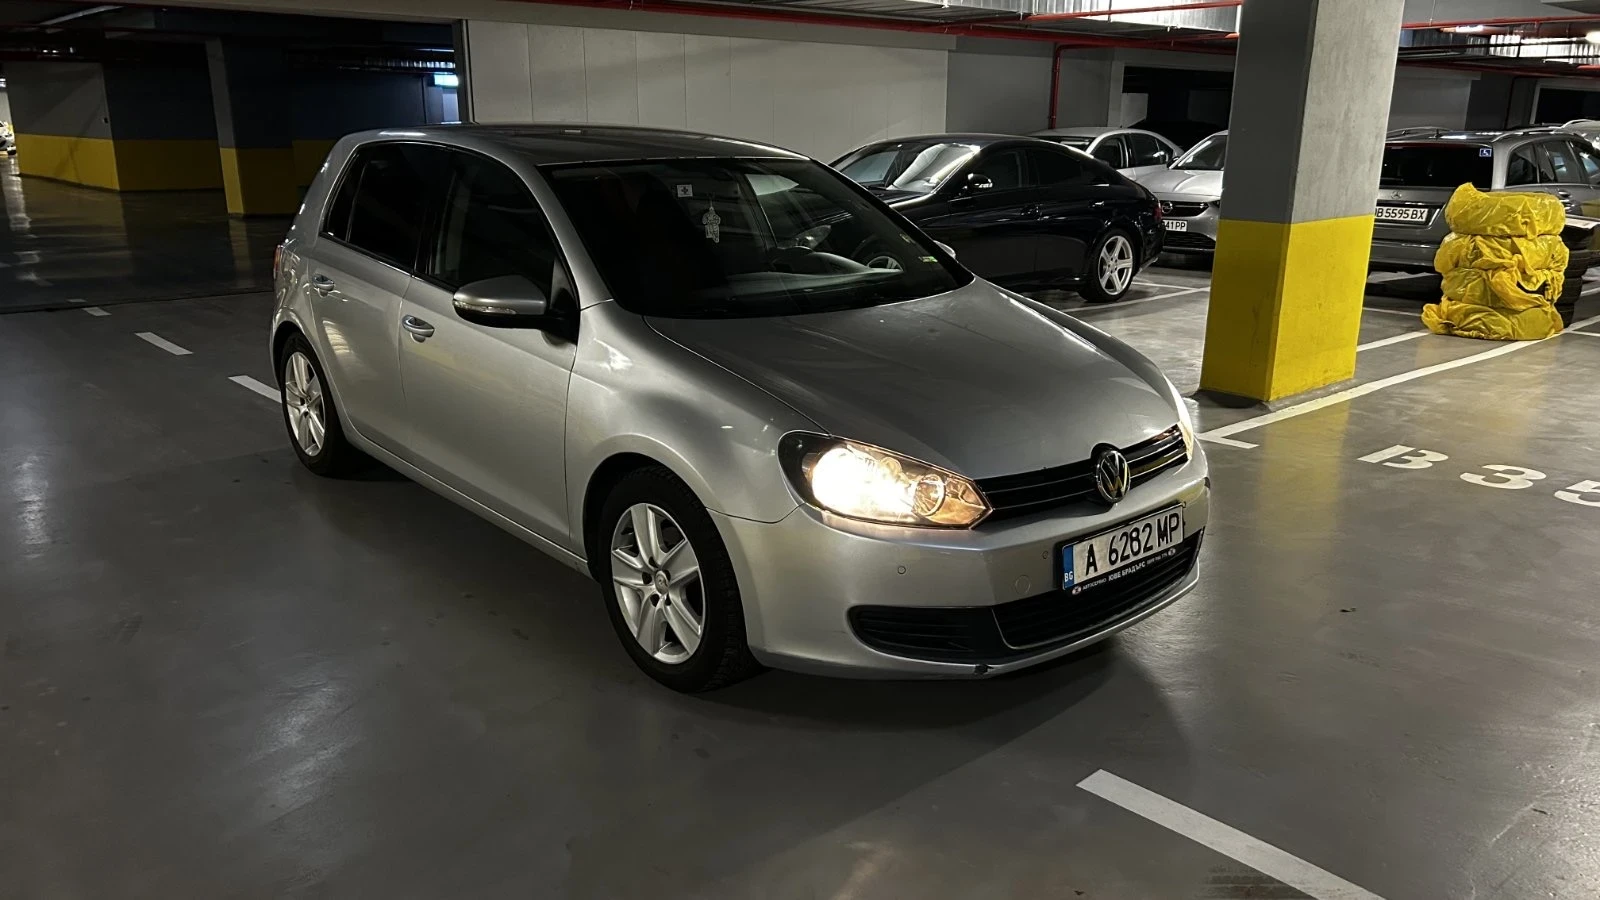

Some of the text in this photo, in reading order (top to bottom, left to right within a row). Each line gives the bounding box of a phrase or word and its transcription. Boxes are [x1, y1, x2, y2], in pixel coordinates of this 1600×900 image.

[1375, 208, 1384, 218] B
[1108, 522, 1153, 566] 6282
[1156, 512, 1180, 548] MP
[1064, 571, 1074, 582] BG
